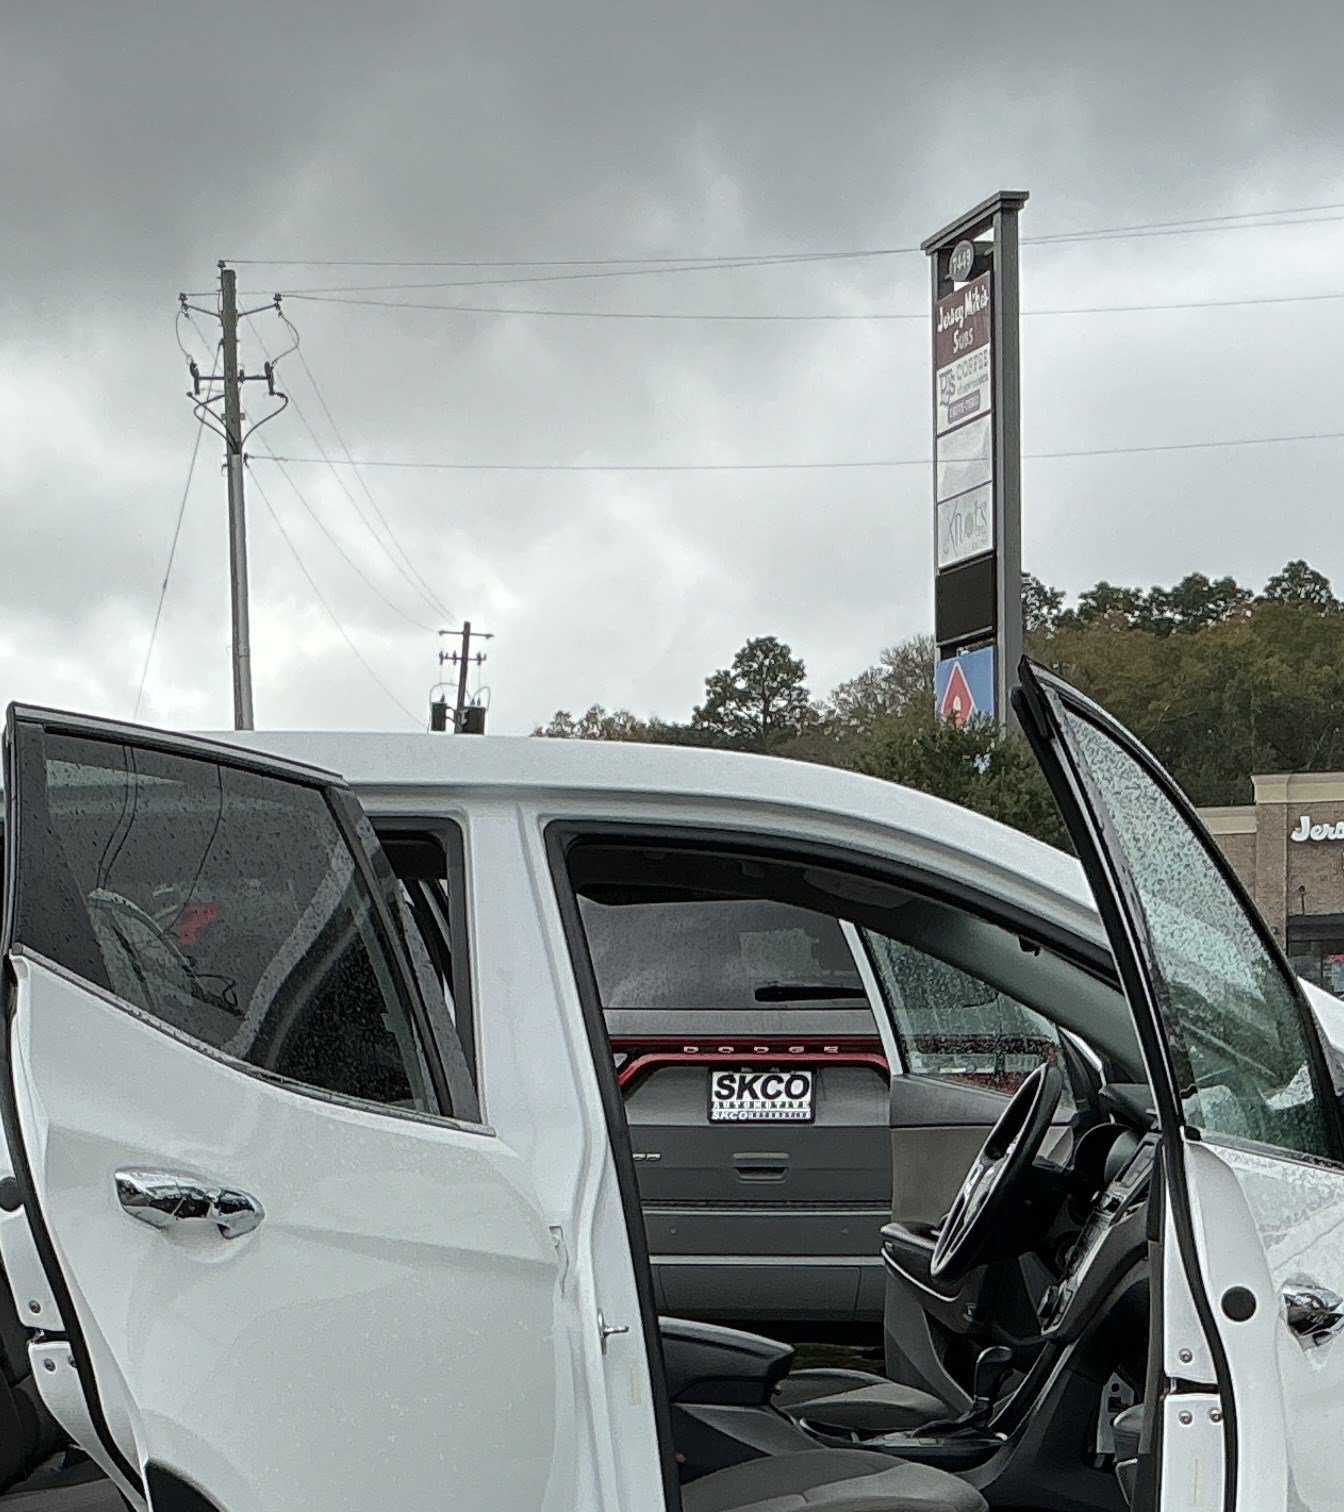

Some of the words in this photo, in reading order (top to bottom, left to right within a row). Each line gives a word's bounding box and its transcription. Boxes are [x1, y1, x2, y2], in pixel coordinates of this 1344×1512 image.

[937, 305, 964, 333] Jersey
[965, 285, 990, 318] Mike's
[683, 1046, 839, 1054] DODGE
[714, 1073, 810, 1100] SKCO
